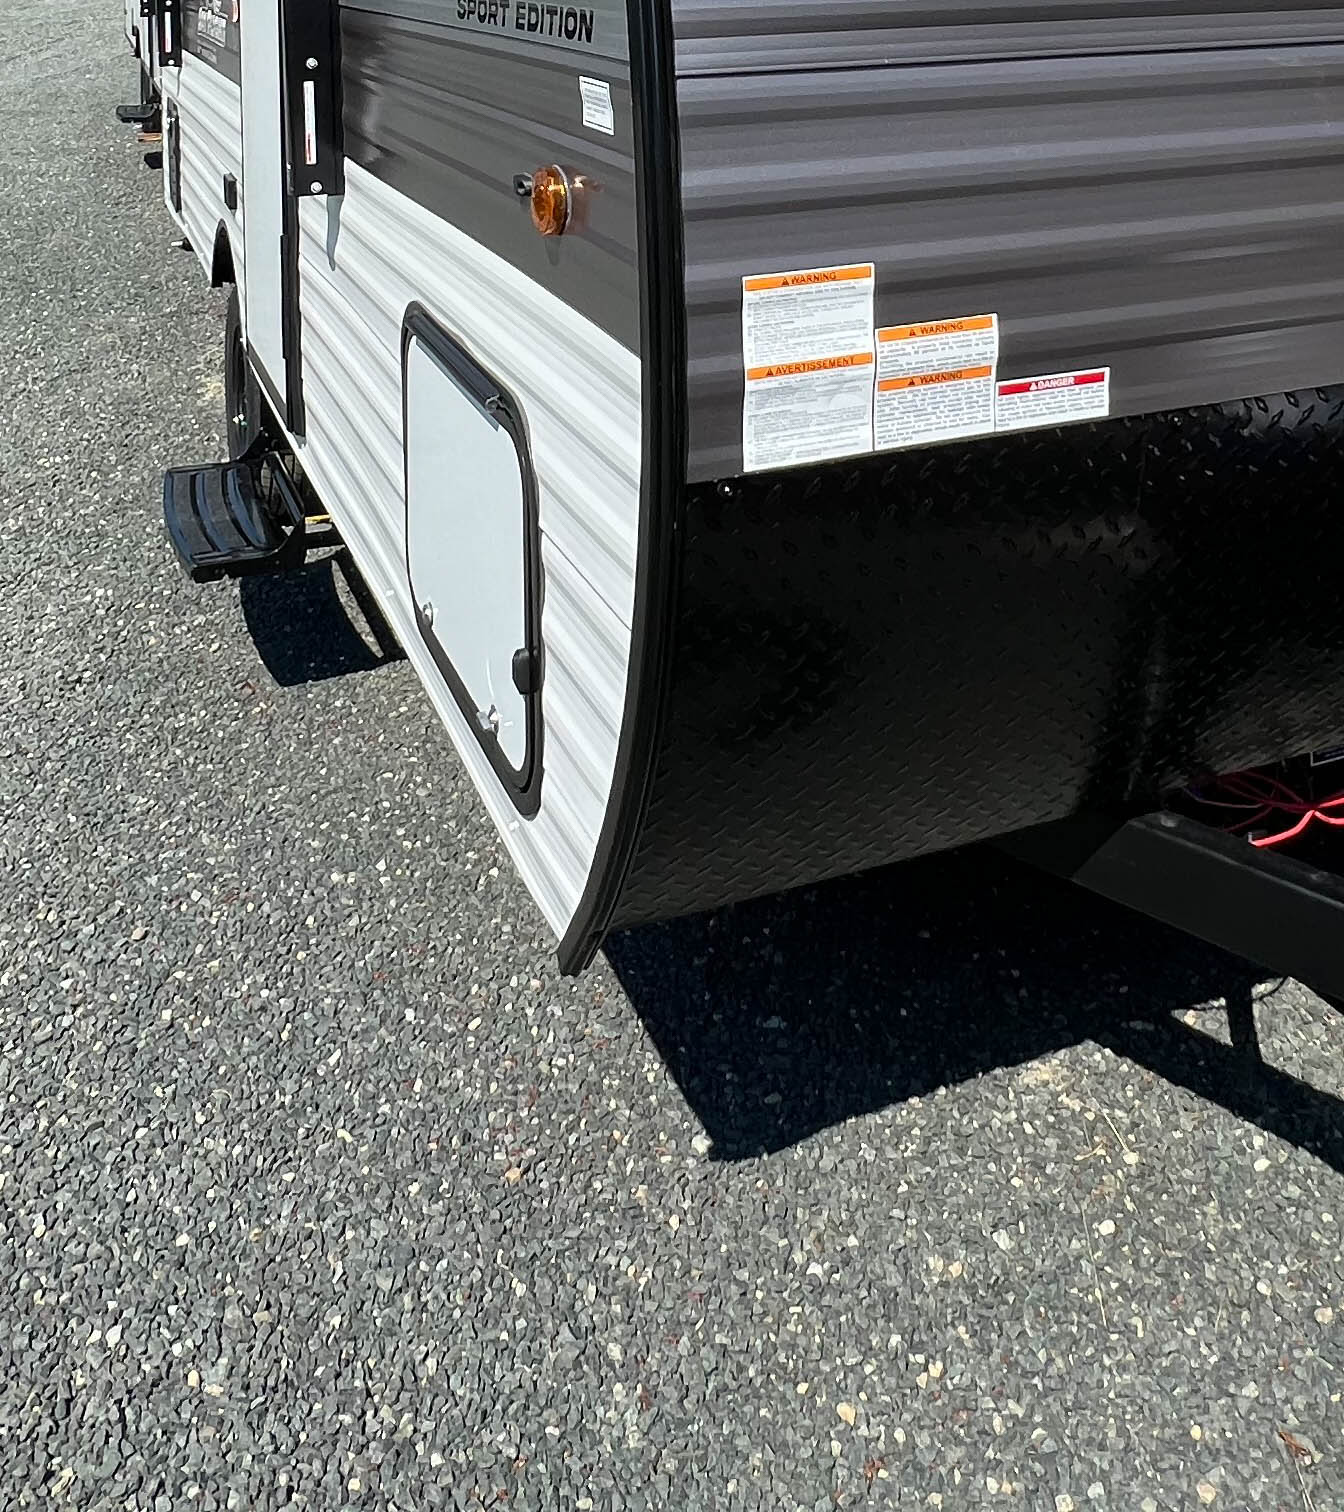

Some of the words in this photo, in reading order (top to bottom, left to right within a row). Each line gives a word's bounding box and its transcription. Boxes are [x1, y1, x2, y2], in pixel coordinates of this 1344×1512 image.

[515, 0, 594, 43] EDITION
[791, 271, 837, 285] WARNING
[920, 322, 964, 335] WARNING
[775, 356, 856, 376] AVERTISSEMENT
[919, 371, 963, 385] WARNING
[1037, 376, 1075, 389] DANGER
